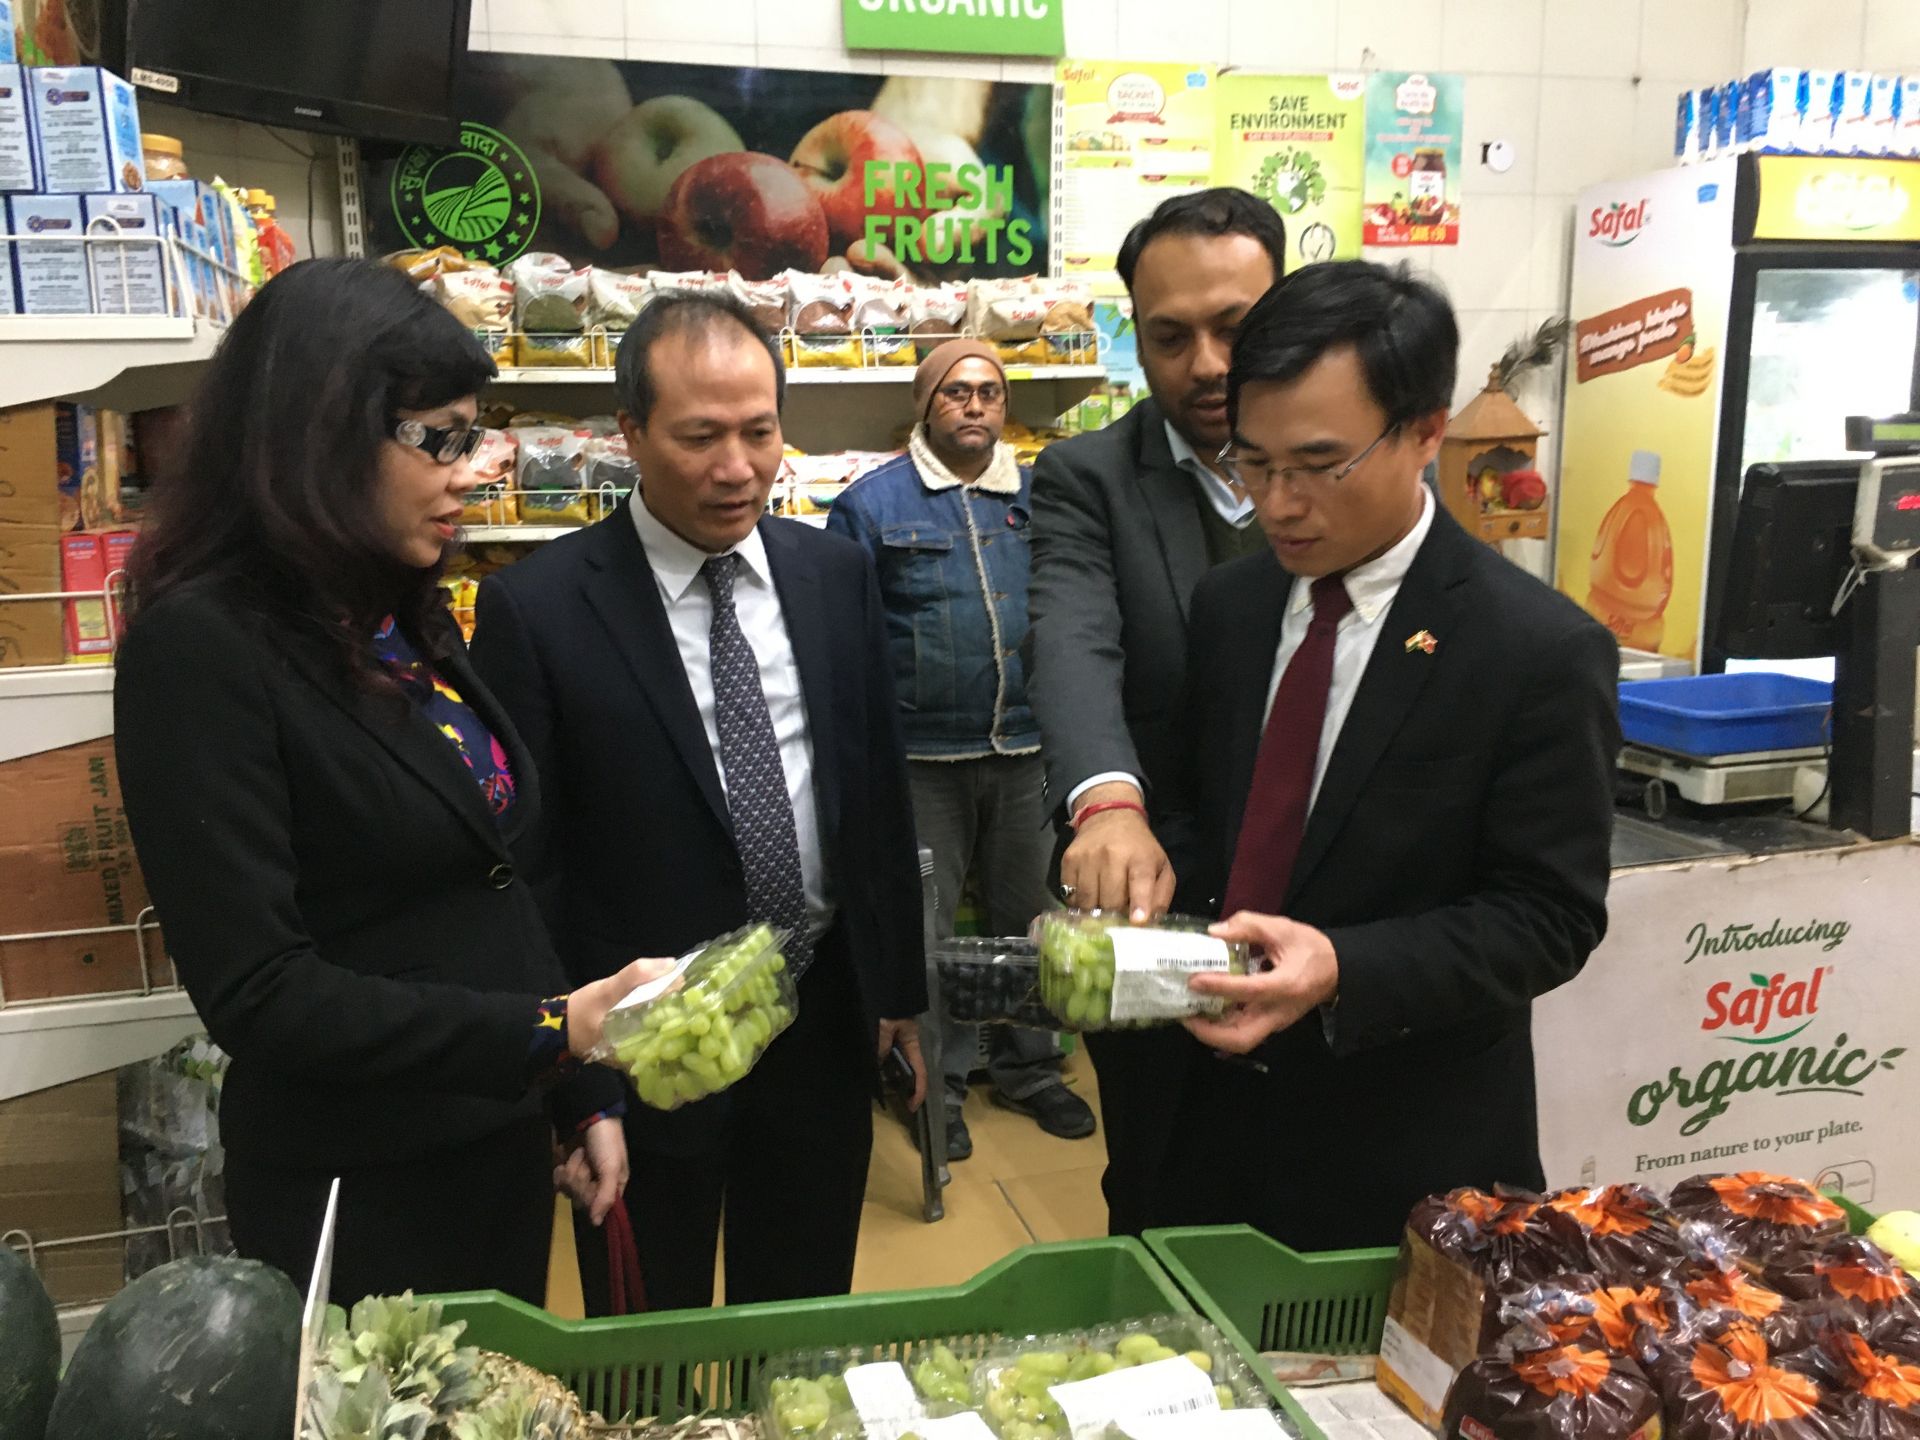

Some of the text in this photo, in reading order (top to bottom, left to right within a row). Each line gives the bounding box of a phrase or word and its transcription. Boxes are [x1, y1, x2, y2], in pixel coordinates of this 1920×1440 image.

[1230, 113, 1347, 130] ENVIRONMENT
[1269, 95, 1309, 112] SAVE
[460, 130, 500, 156] वादा
[864, 160, 1014, 212] FRESH
[864, 215, 1033, 265] FRUITS
[1589, 199, 1647, 240] Safal
[89, 757, 124, 924] MIXED FRUIT JAM
[1684, 918, 1851, 964] Introducing
[1701, 967, 1824, 1034] Safal
[1627, 1034, 1877, 1136] organic
[1634, 1119, 1863, 1172] From nature to your plate.
